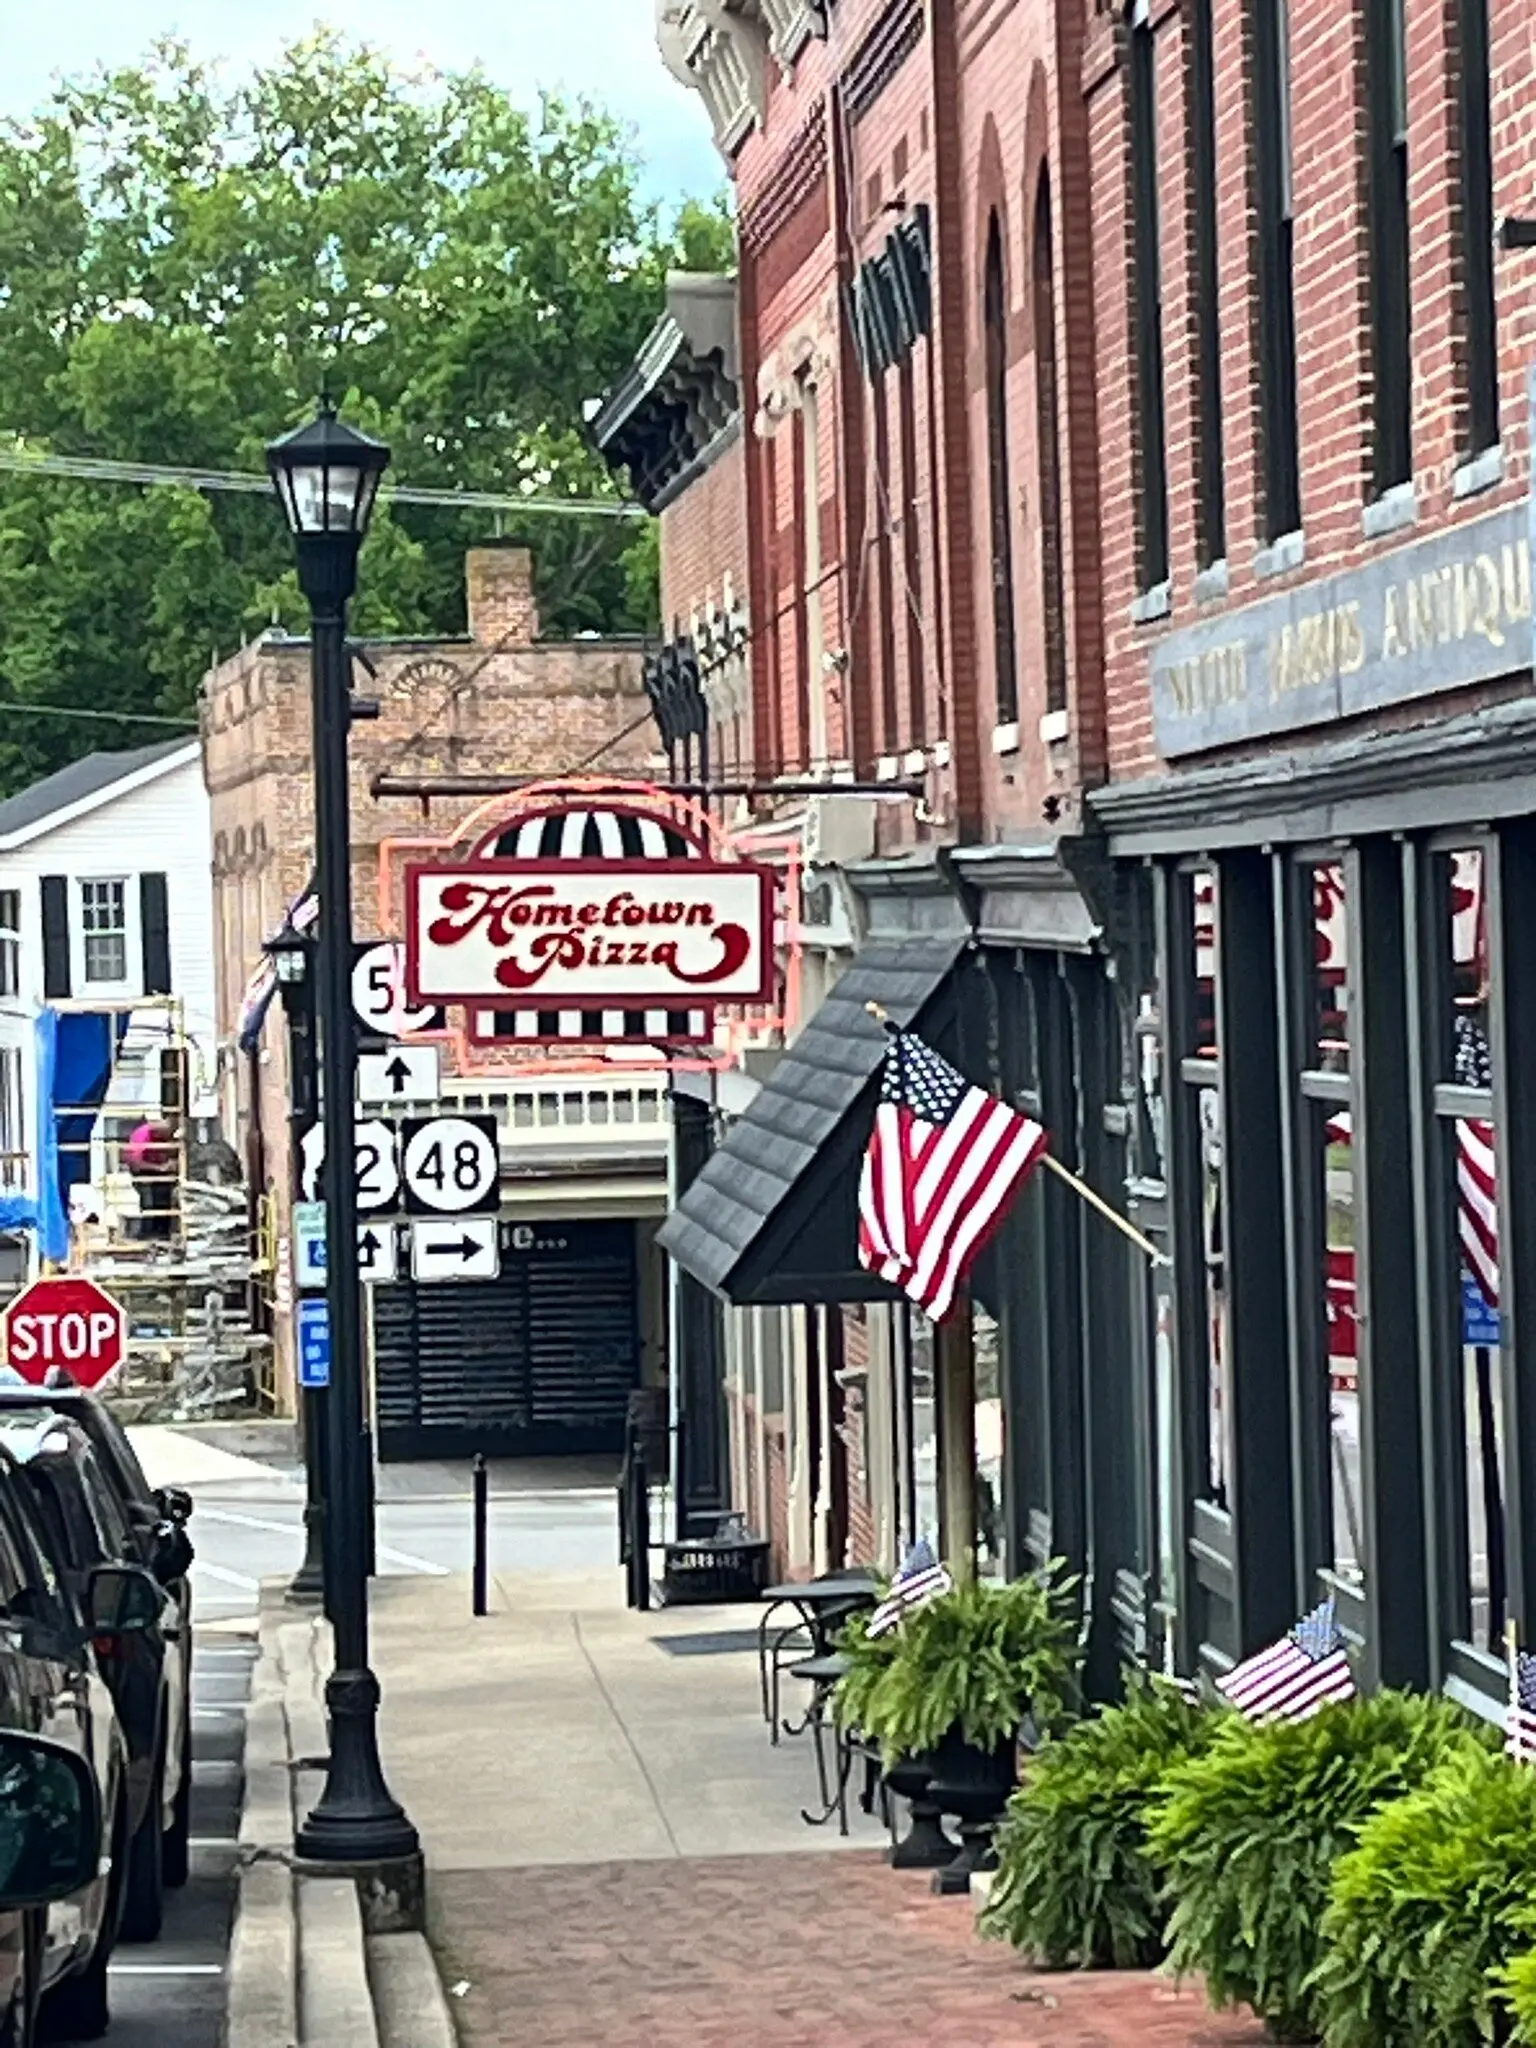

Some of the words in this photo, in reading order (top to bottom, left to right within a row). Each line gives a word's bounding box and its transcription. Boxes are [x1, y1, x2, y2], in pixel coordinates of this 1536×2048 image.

[427, 882, 715, 947] Hometown
[494, 923, 751, 988] Pizza
[415, 1139, 482, 1192] 48
[10, 1312, 116, 1362] STOP
